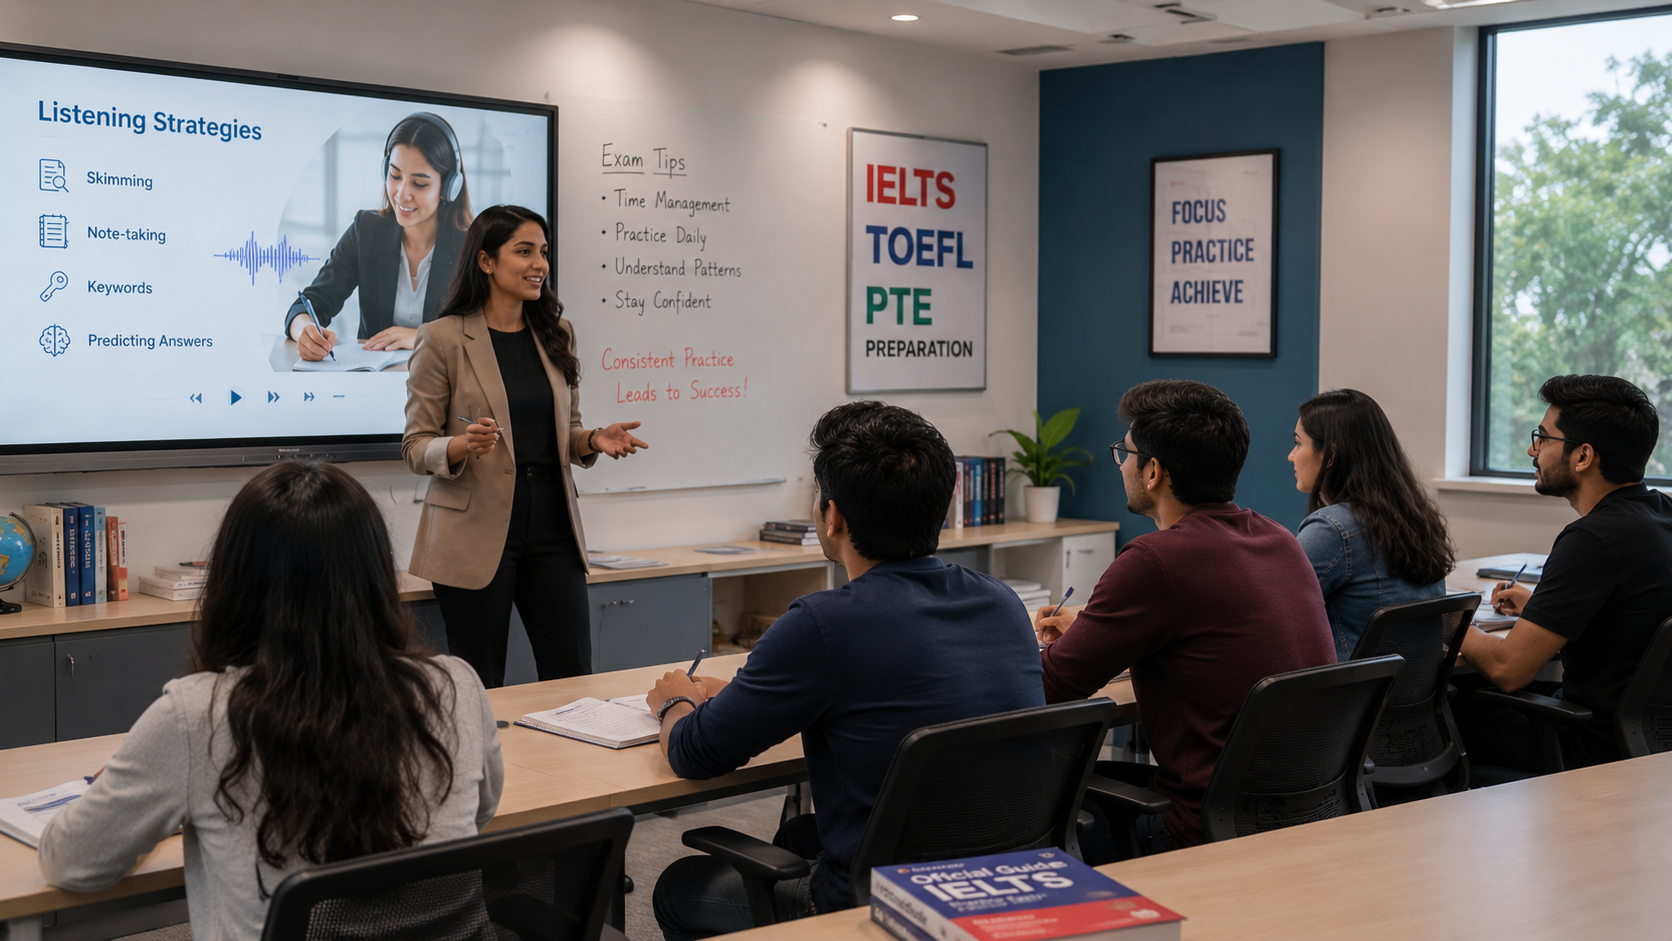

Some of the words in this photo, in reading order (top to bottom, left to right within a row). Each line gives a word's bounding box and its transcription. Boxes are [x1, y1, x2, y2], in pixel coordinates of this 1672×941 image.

[38, 100, 146, 135] Listening
[153, 111, 262, 142] Strategies
[602, 143, 644, 168] Exam
[653, 147, 685, 179] Tips
[86, 171, 153, 191] Skimming
[866, 163, 956, 210] IELTS
[614, 188, 646, 208] Time
[655, 190, 731, 218] Management
[1171, 198, 1227, 225] FOCUS
[87, 226, 166, 245] Note-taking
[615, 222, 667, 243] Practice
[676, 225, 707, 252] Daily
[865, 224, 974, 269] TOEFL
[1171, 237, 1255, 264] PRACTICE
[615, 257, 685, 276] Understand
[694, 258, 742, 277] Patterns
[87, 280, 153, 297] Keywords
[1170, 279, 1244, 304] ACHIEVE
[615, 290, 645, 316] Stay
[653, 290, 712, 315] Confident
[866, 285, 933, 326] PTE
[88, 333, 156, 350] Predicting
[159, 334, 213, 348] Answers
[865, 339, 973, 358] PREPARATION
[602, 347, 675, 371] Consistent
[684, 346, 734, 368] Practice
[617, 381, 657, 404] Leads
[666, 382, 680, 401] to
[690, 376, 748, 400] Success!
[922, 871, 1075, 902] IELTS
